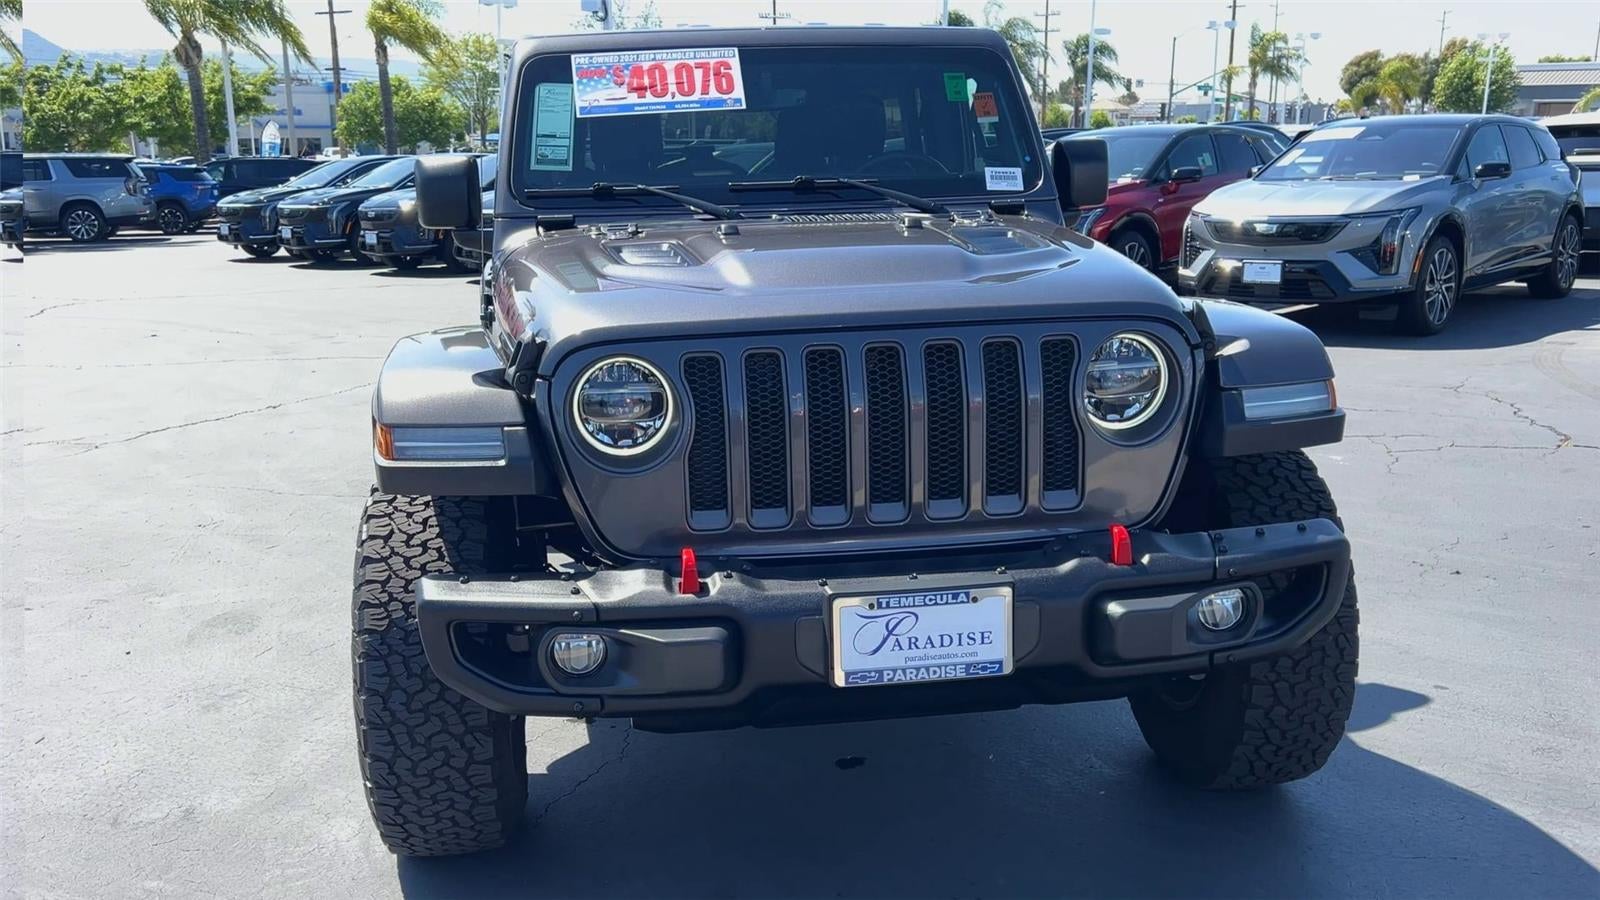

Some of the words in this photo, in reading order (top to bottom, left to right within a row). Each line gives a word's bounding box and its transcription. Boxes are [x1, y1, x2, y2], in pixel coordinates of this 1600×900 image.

[575, 54, 619, 65] PRE-OWNED
[620, 54, 638, 63] 2021
[638, 52, 655, 62] JEEP
[655, 51, 695, 60] WRANGLER
[695, 49, 734, 59] UNLIMITED
[612, 60, 735, 99] $40,076
[878, 592, 969, 608] TEMECULA
[852, 611, 993, 656] PARADISE
[904, 651, 979, 664] paradiseautos.com
[882, 664, 967, 682] PARADISE
